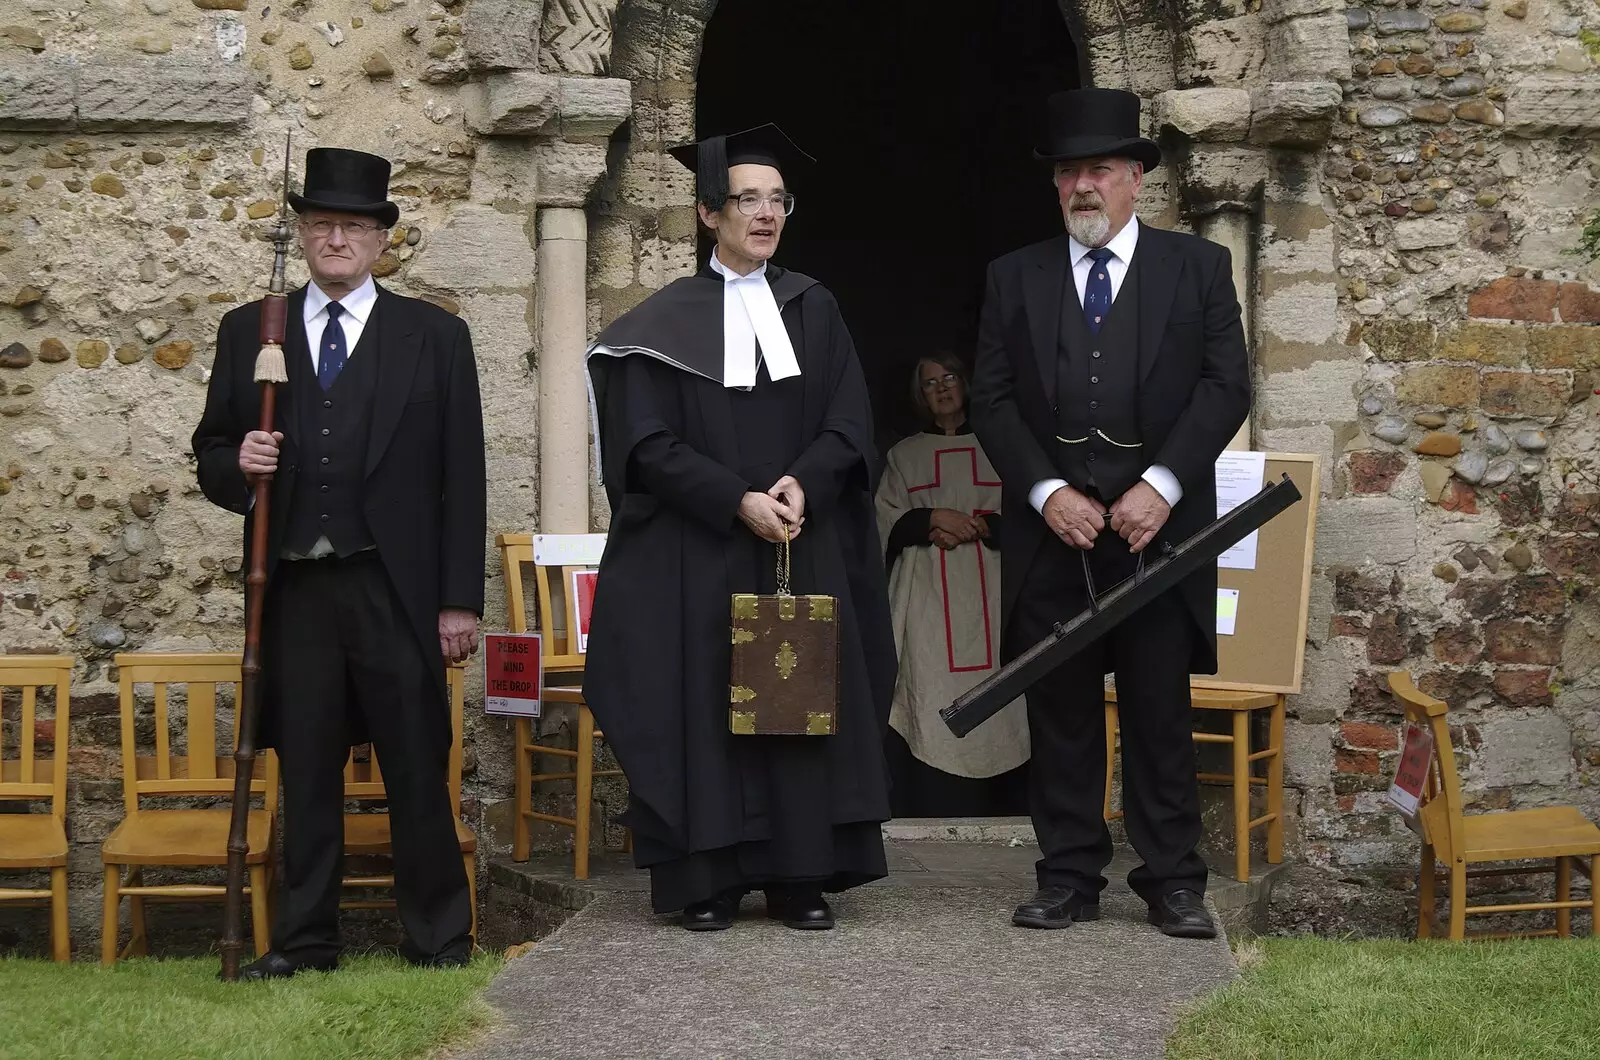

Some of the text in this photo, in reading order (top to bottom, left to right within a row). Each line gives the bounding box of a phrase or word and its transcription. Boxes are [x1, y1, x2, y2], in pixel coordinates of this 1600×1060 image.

[498, 642, 529, 654] PLEASE
[503, 661, 525, 673] MIND
[491, 680, 508, 691] THE
